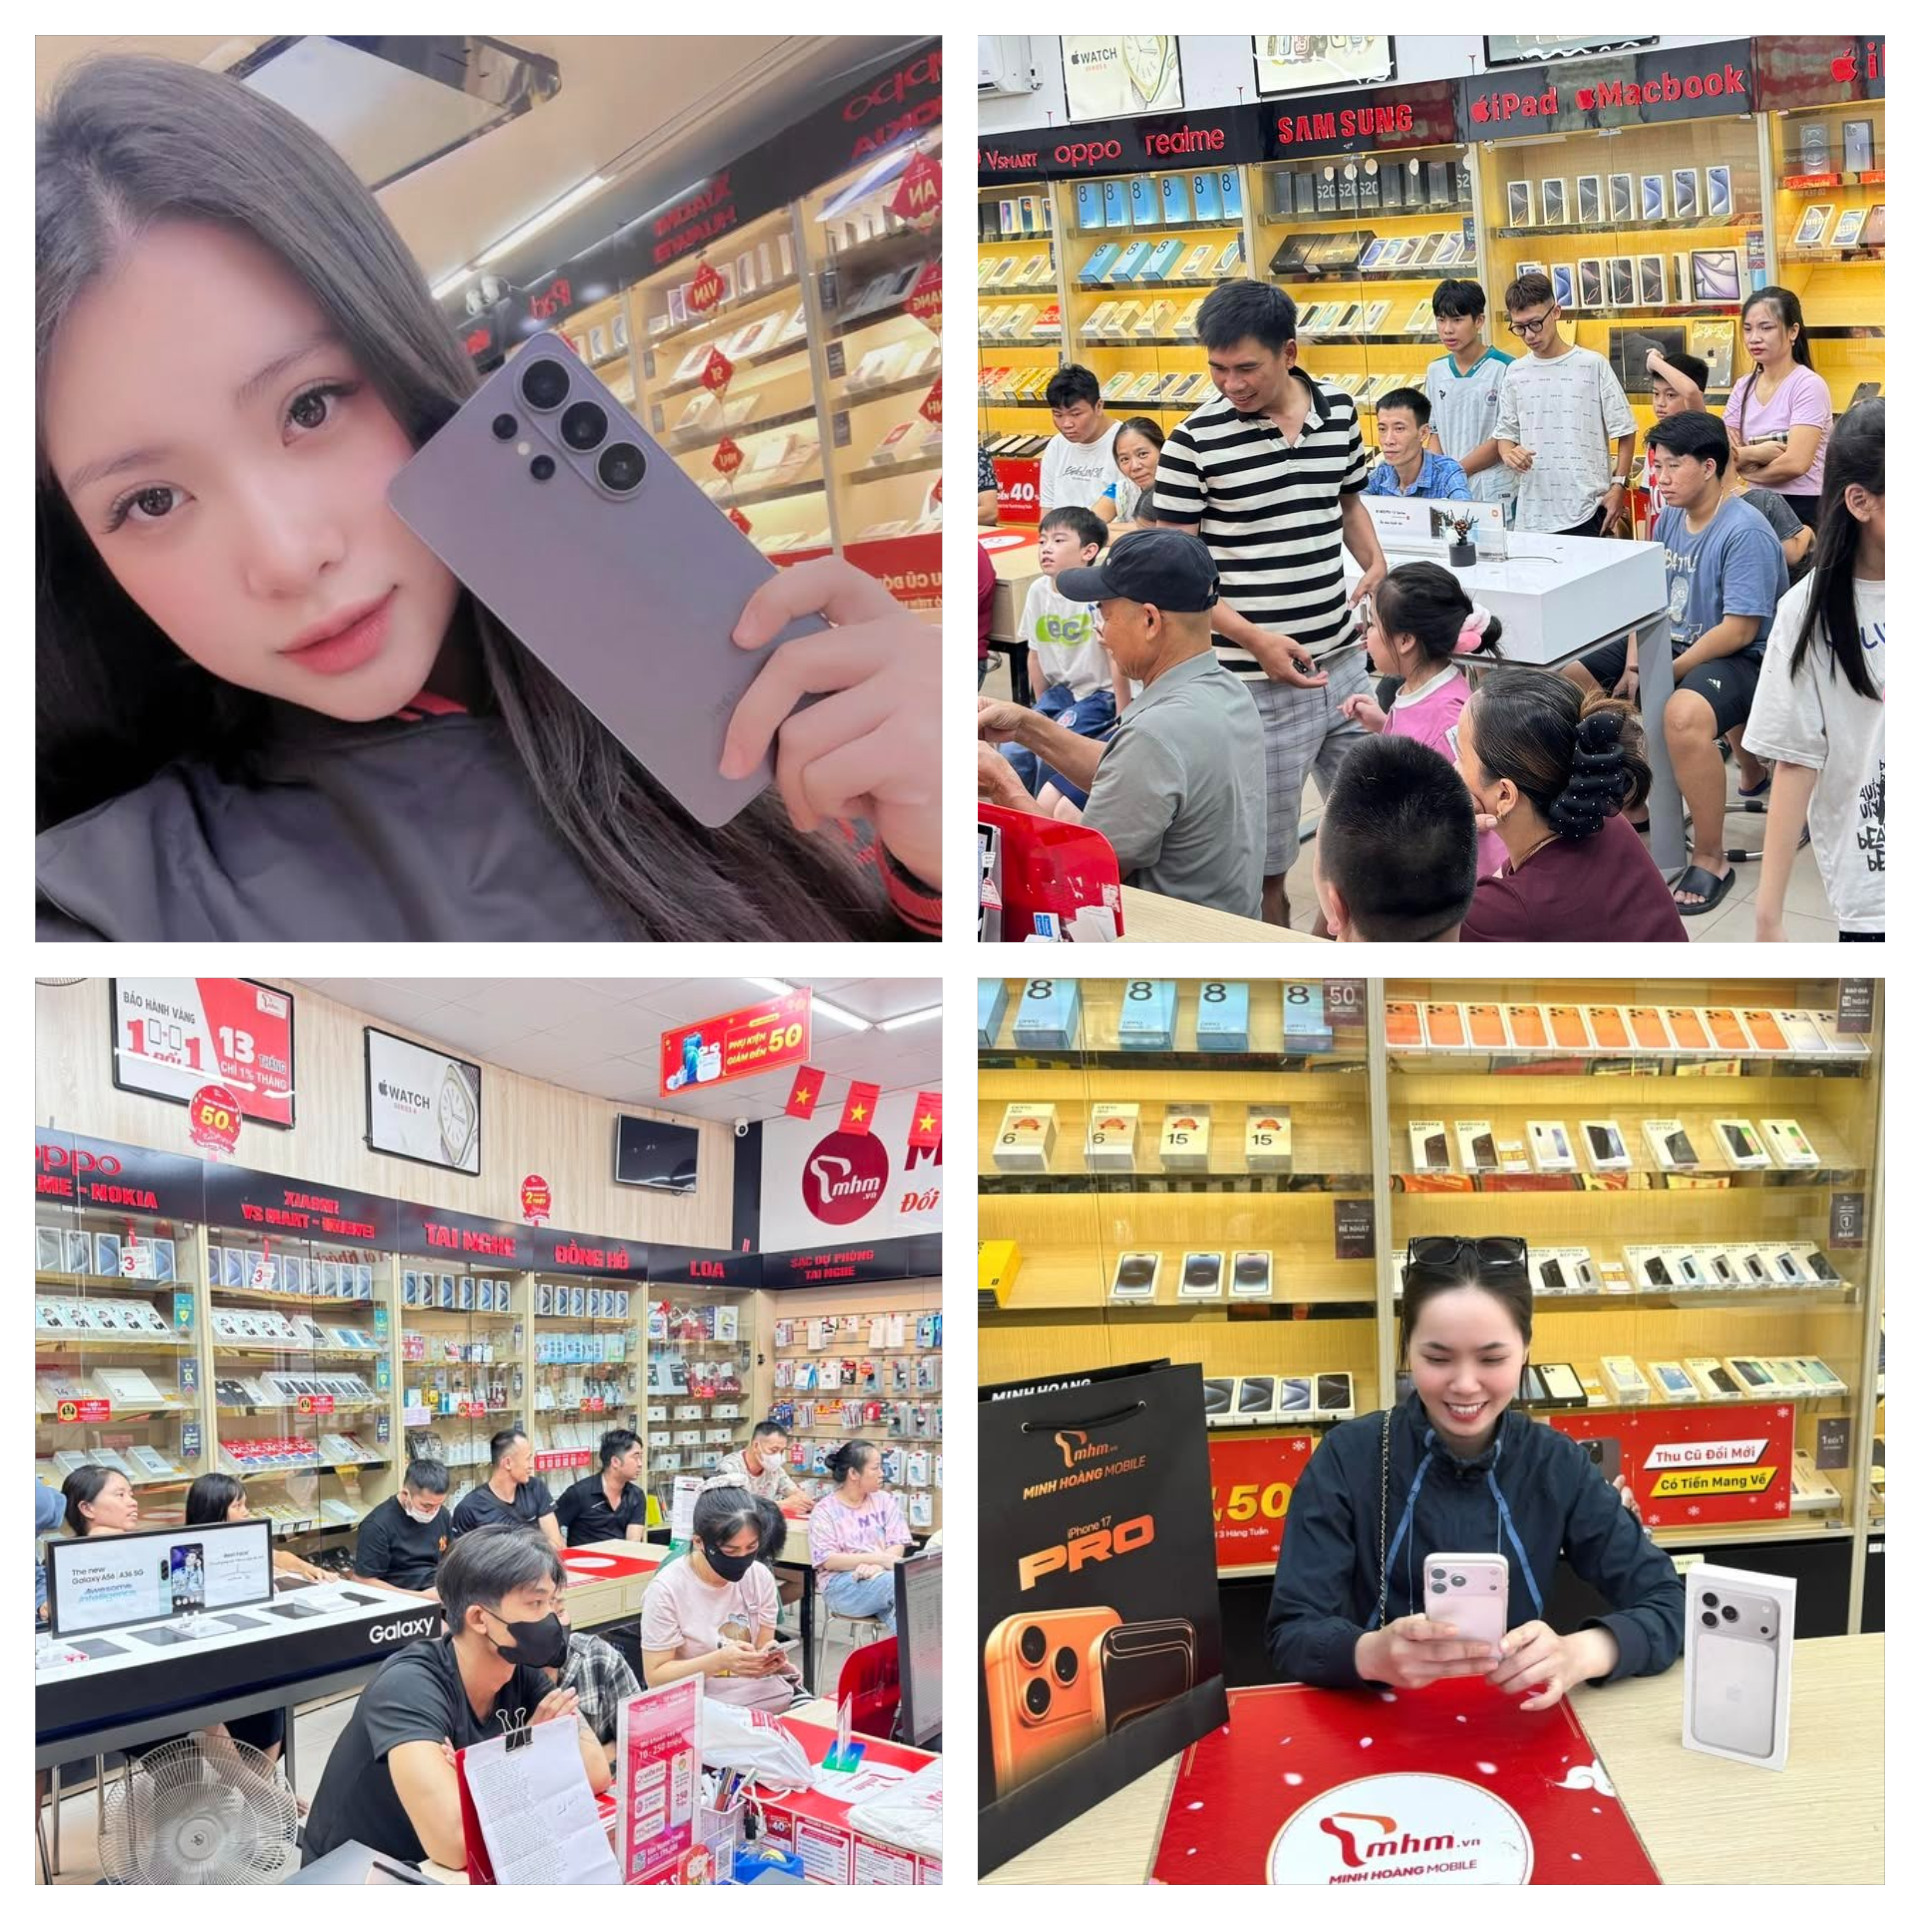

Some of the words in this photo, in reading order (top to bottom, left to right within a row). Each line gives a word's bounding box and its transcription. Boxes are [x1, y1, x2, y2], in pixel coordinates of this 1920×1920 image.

[1080, 47, 1118, 65] WATCH
[1491, 86, 1559, 121] iPad
[1596, 64, 1746, 109] Macbook
[1146, 124, 1225, 156] realme
[1054, 140, 1122, 168] oppo
[1132, 181, 1142, 199] 8
[1163, 179, 1172, 197] 8
[1194, 176, 1204, 194] 8
[1222, 173, 1232, 192] 8
[1456, 174, 1471, 188] S2
[1079, 186, 1088, 202] 8
[1106, 183, 1115, 200] 8
[1027, 979, 1052, 1000] 8
[1128, 981, 1152, 1001] 8
[1203, 983, 1227, 1003] 8
[1287, 985, 1310, 1004] 8
[145, 998, 169, 1017] HÀNH
[172, 1006, 195, 1025] VÀNG
[219, 1025, 255, 1065] 13
[768, 1022, 803, 1053] 50
[240, 1066, 254, 1082] 1%
[257, 1072, 287, 1091] THÁNG
[389, 1086, 430, 1109] WATCH
[1002, 1133, 1016, 1144] 6
[1093, 1133, 1105, 1144] 6
[1167, 1133, 1188, 1145] 15
[1251, 1134, 1272, 1146] 15
[832, 1175, 880, 1197] mhm
[91, 1183, 158, 1210] NOKIA
[424, 1222, 458, 1249] TAI
[463, 1231, 516, 1258] NGHE
[555, 1237, 604, 1268] ĐỒNG
[124, 1256, 135, 1271] 3
[690, 1261, 724, 1279] LOA
[255, 1269, 263, 1282] 3
[1656, 1451, 1681, 1462] Thu
[1684, 1449, 1702, 1461] Cũ
[1732, 1445, 1755, 1459] Mới
[1023, 1480, 1057, 1500] MINH
[1058, 1468, 1103, 1491] HOÀNG
[1104, 1455, 1147, 1477] MOBILE
[1661, 1478, 1678, 1490] Có
[1681, 1475, 1709, 1489] Tiền
[1712, 1476, 1747, 1488] Mang
[1227, 1482, 1293, 1521] 50
[1067, 1520, 1100, 1539] iPhone
[1100, 1515, 1112, 1530] 17
[1018, 1514, 1155, 1591] PRO
[72, 1568, 86, 1577] The
[88, 1567, 106, 1575] new
[72, 1576, 101, 1586] Galaxy
[102, 1572, 116, 1581] A56
[119, 1570, 133, 1579] A36
[134, 1568, 144, 1577] 5G
[84, 1583, 132, 1595] Awesome
[369, 1616, 434, 1644] Galaxy
[1329, 1871, 1369, 1885] MINH
[1370, 1866, 1425, 1880] HOÀNG
[1426, 1859, 1478, 1874] MOBILE
